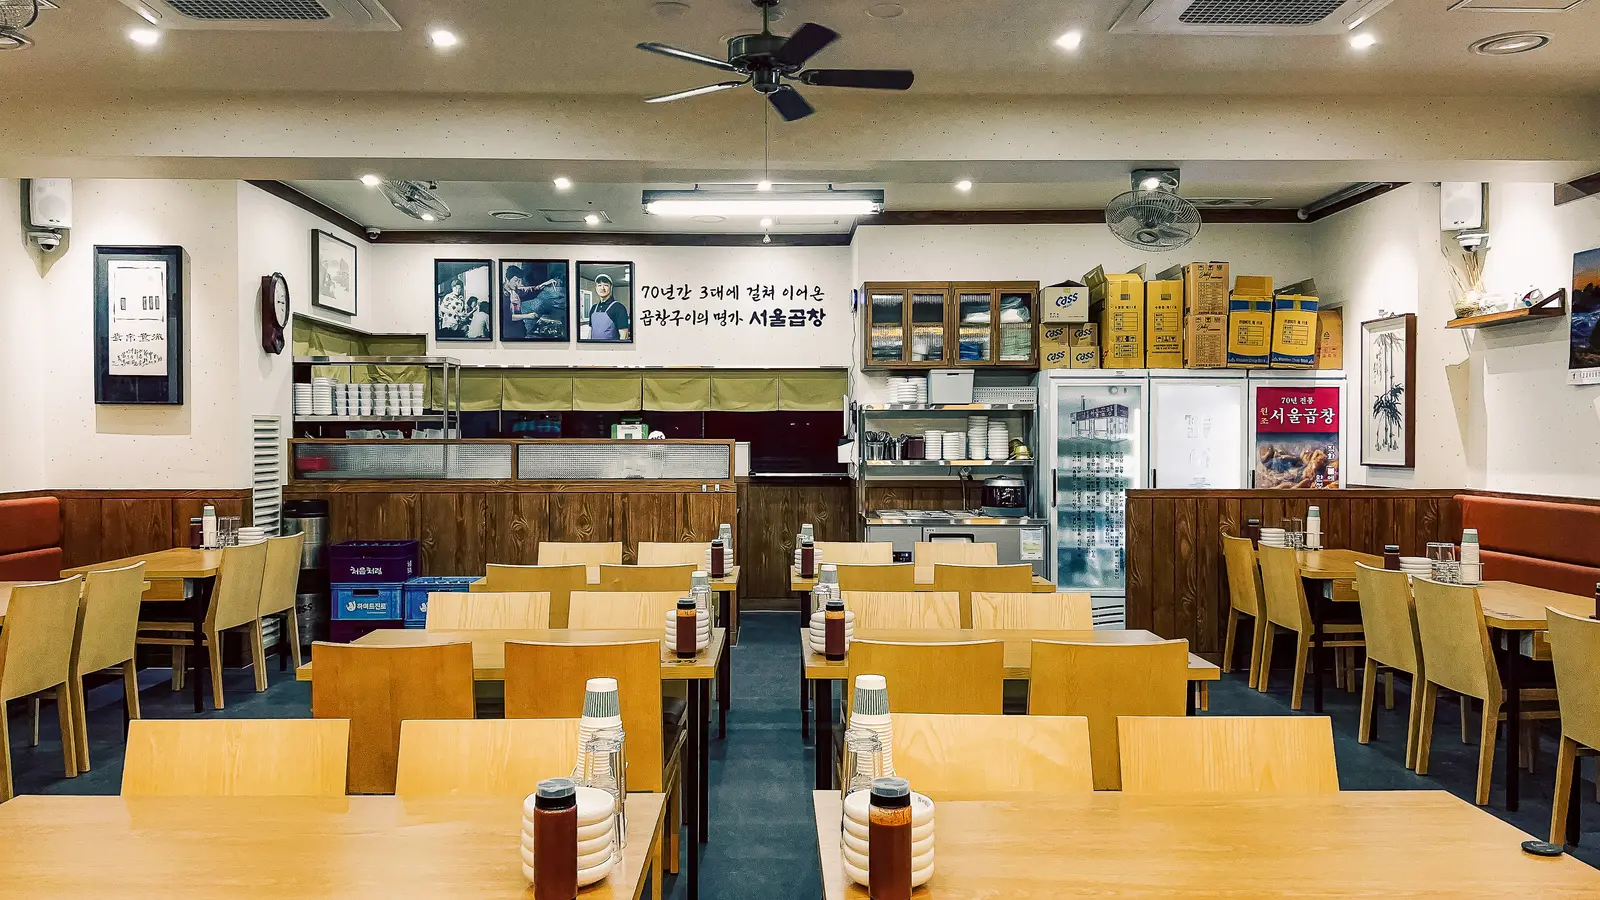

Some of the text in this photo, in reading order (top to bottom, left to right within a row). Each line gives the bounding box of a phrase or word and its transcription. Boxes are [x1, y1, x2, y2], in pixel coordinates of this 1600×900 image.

[641, 283, 824, 301] 70년간 3대에 걸쳐 이어온
[1055, 292, 1078, 307] Cass
[640, 308, 826, 327] 곱창구이의 명가 서울곱창
[1045, 328, 1063, 338] Cass
[1074, 328, 1093, 338] Cass
[1047, 350, 1065, 361] Cass
[1076, 350, 1094, 361] Cass
[1281, 396, 1314, 405] 70년 전통
[1269, 407, 1336, 424] 서울곱창
[350, 566, 383, 575] 처음처럼
[357, 602, 387, 611] 하이트진로
